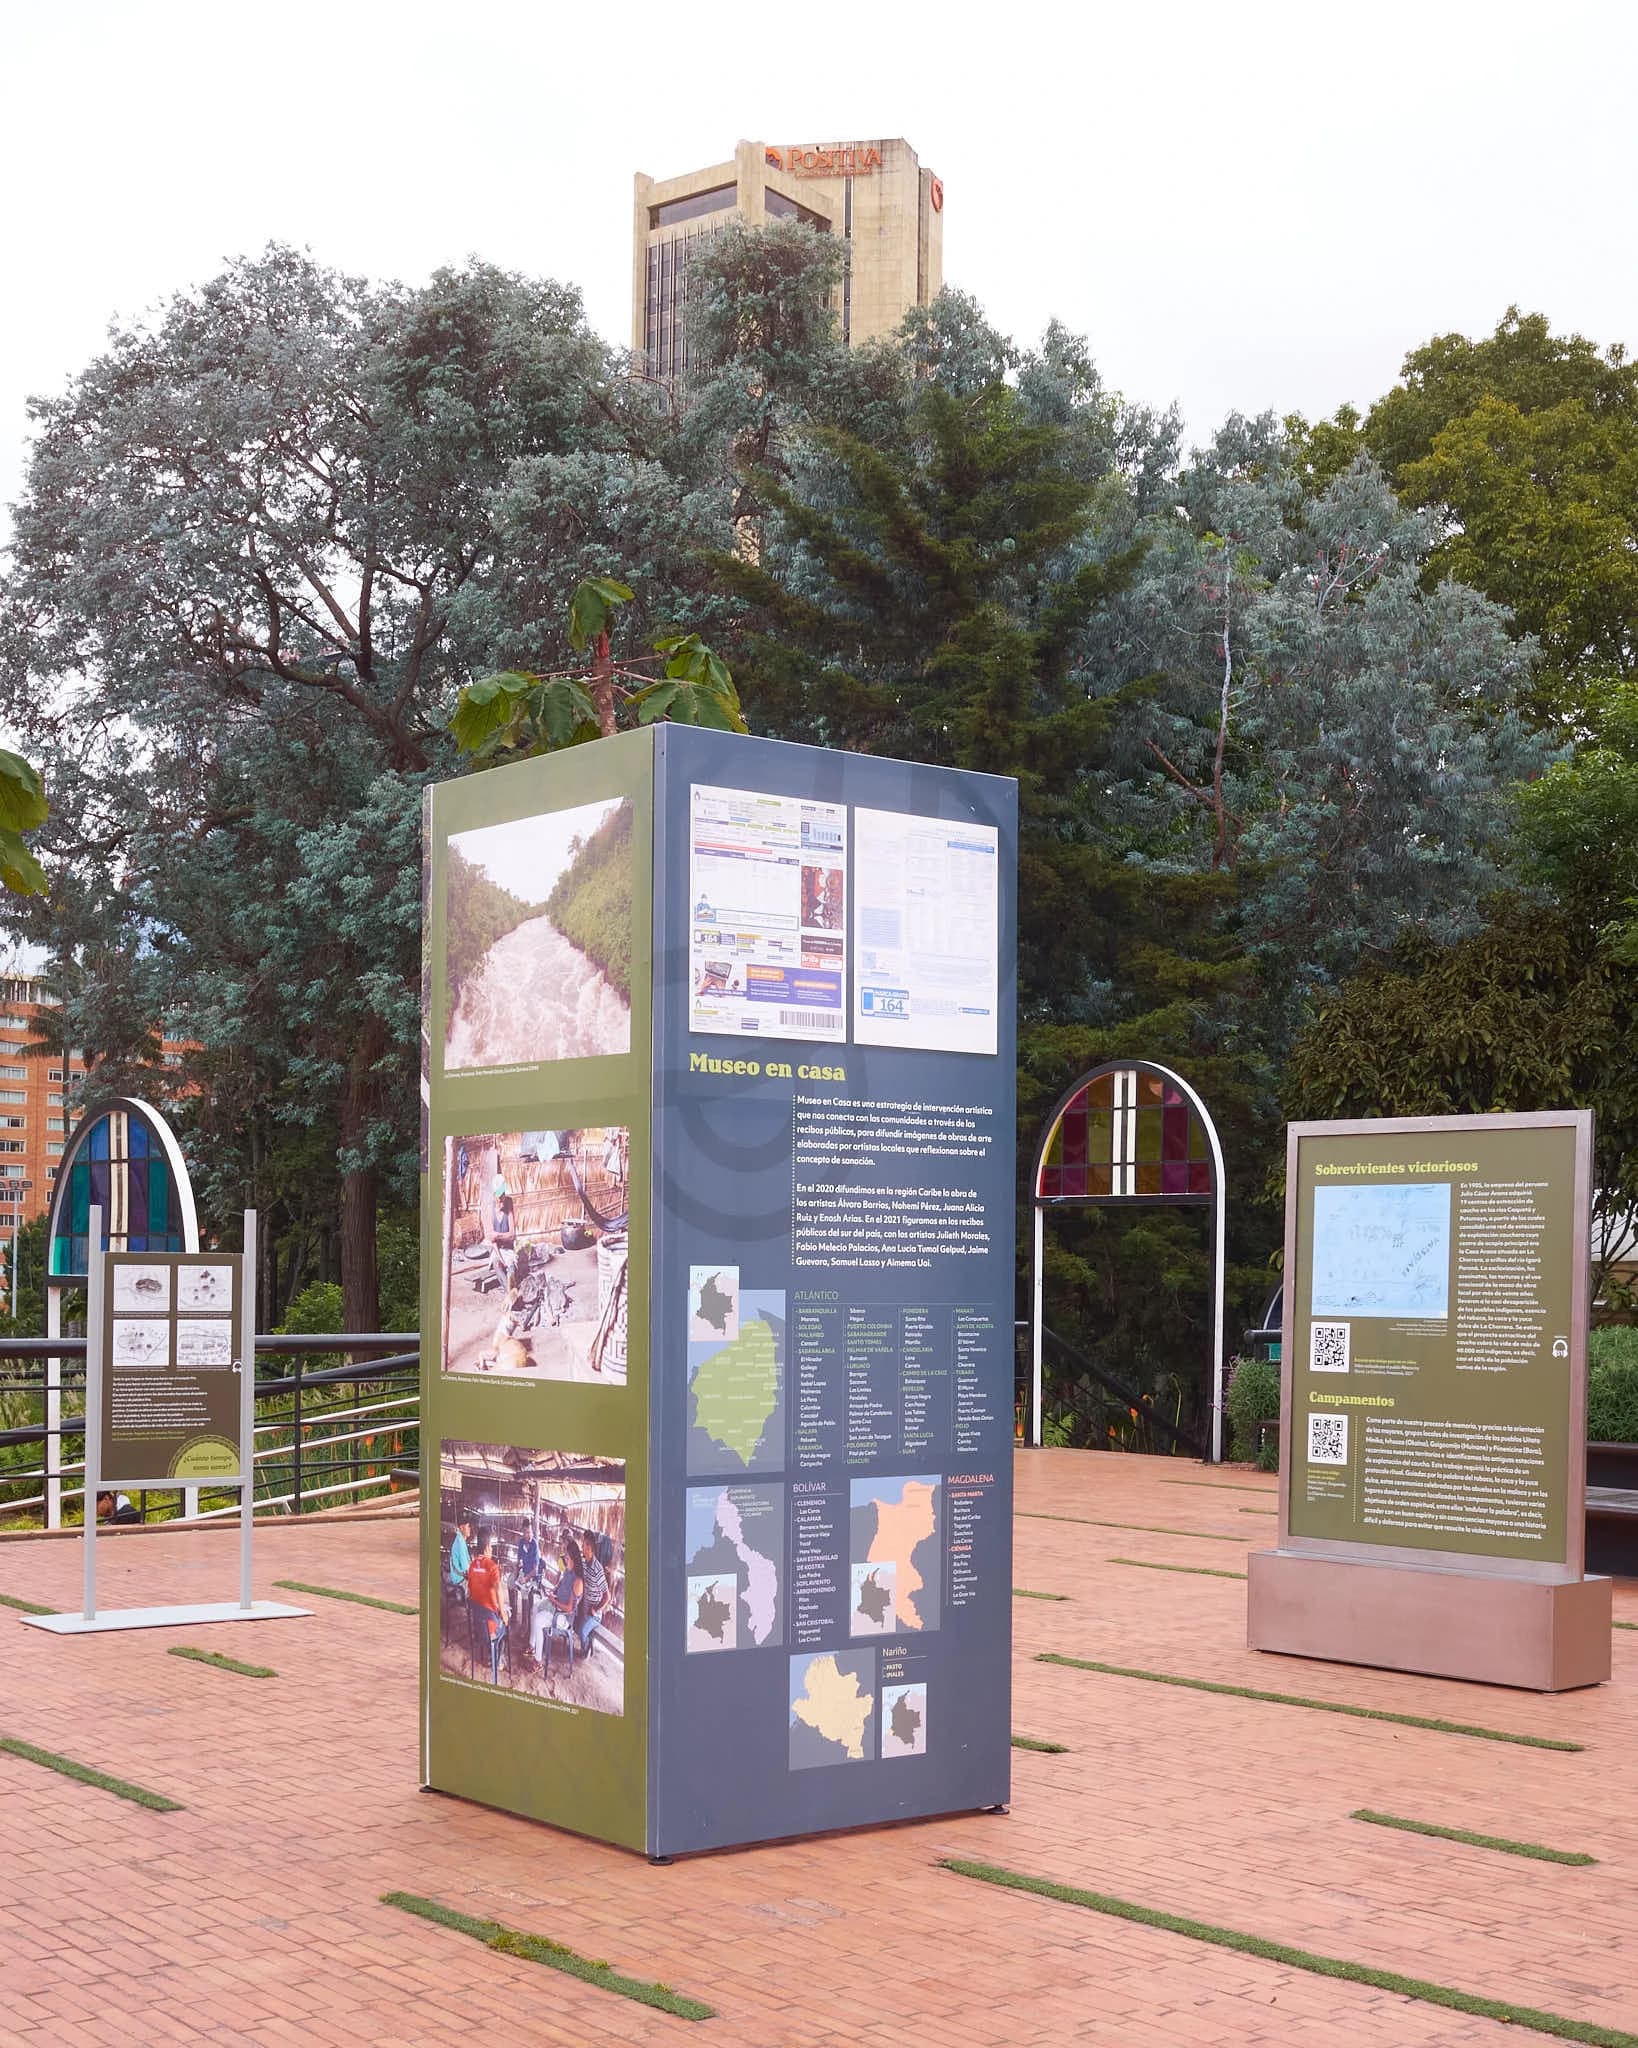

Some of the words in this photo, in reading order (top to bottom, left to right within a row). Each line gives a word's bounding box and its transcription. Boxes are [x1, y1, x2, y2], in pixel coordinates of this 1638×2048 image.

[787, 148, 881, 170] POSITIVA
[880, 998, 904, 1012] 164
[689, 1053, 760, 1076] Museo
[766, 1062, 792, 1078] en
[798, 1064, 846, 1080] casa
[797, 1096, 822, 1105] Museo
[832, 1098, 851, 1107] Casa
[876, 1101, 912, 1111] estrategia
[912, 1102, 922, 1110] de
[797, 1112, 811, 1120] que
[869, 1114, 880, 1123] las
[880, 1116, 927, 1125] comunidades
[955, 1119, 964, 1127] de
[965, 1119, 975, 1128] los
[797, 1126, 823, 1135] recibos
[824, 1127, 856, 1137] públicos,
[857, 1130, 874, 1138] para
[937, 1132, 947, 1140] de
[947, 1133, 967, 1141] obras
[968, 1134, 976, 1142] de
[797, 1140, 838, 1150] elaboradas
[839, 1144, 851, 1152] por
[852, 1143, 879, 1152] artistas
[880, 1144, 905, 1153] locales
[906, 1146, 919, 1155] que
[920, 1146, 958, 1155] reflexionan
[959, 1147, 978, 1156] sobre
[979, 1148, 985, 1156] el
[831, 1156, 840, 1164] de
[1315, 1162, 1405, 1176] Sobrevivientes
[1408, 1160, 1478, 1174] victoriosos
[796, 1184, 806, 1192] En
[807, 1184, 814, 1193] el
[815, 1185, 834, 1193] 2020
[835, 1185, 875, 1195] difundimos
[886, 1187, 893, 1195] la
[894, 1188, 917, 1198] región
[918, 1188, 942, 1197] Caribe
[942, 1189, 949, 1197] la
[950, 1189, 967, 1198] obra
[968, 1190, 976, 1198] de
[796, 1198, 807, 1207] los
[808, 1199, 836, 1208] artistas
[862, 1200, 890, 1210] Barrios,
[943, 1203, 964, 1211] Juana
[965, 1203, 984, 1212] Alicia
[796, 1213, 812, 1222] Ruiz
[813, 1215, 818, 1223] y
[865, 1215, 874, 1223] En
[875, 1215, 882, 1223] el
[883, 1215, 900, 1224] 2021
[902, 1216, 937, 1226] figuramos
[948, 1217, 958, 1225] los
[959, 1218, 983, 1226] recibos
[796, 1228, 827, 1238] públicos
[827, 1229, 839, 1237] del
[852, 1229, 864, 1238] del
[897, 1230, 908, 1238] los
[909, 1230, 935, 1239] artistas
[796, 1242, 817, 1251] Fabio
[848, 1244, 880, 1253] Palacios,
[881, 1244, 896, 1252] Ana
[968, 1246, 988, 1254] Jaime
[831, 1258, 858, 1266] Samuel
[859, 1258, 880, 1266] Lasso
[881, 1260, 885, 1268] y
[794, 1290, 838, 1300] ATLÁNTICO
[1309, 1392, 1394, 1406] Campamentos
[948, 1474, 994, 1484] MAGDALENA
[793, 1482, 826, 1492] BOLÍVAR
[882, 1646, 907, 1656] Nariño
